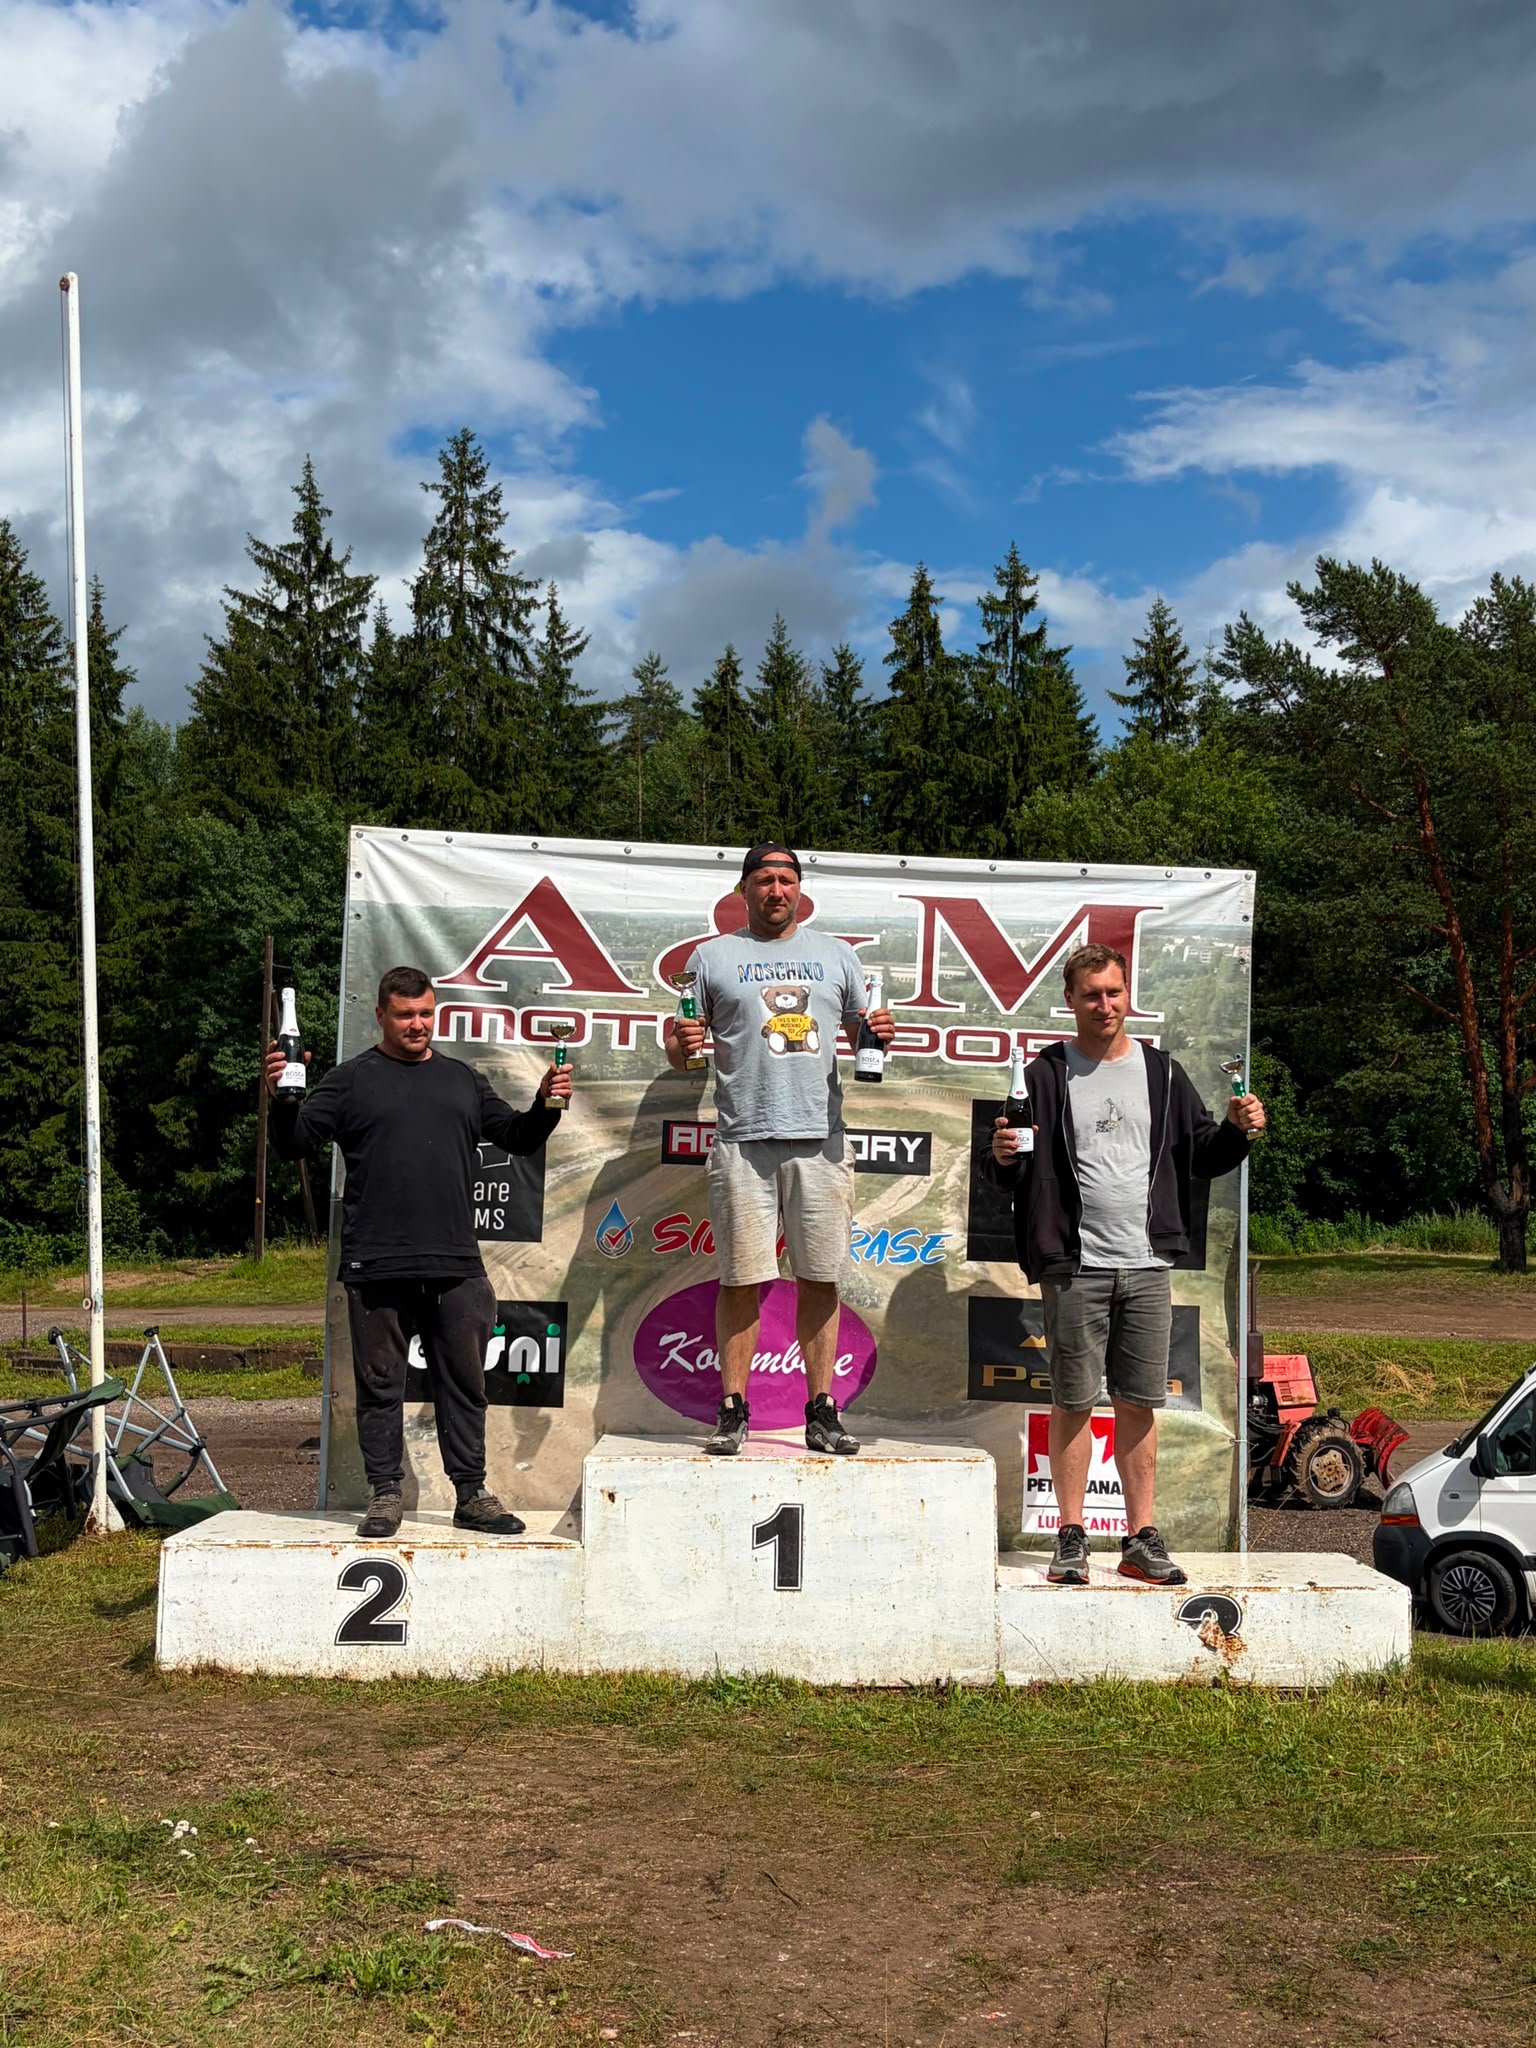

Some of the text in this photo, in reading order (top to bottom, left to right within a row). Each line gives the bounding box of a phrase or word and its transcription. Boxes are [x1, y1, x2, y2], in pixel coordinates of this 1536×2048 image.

[431, 875, 650, 998] A
[888, 891, 1169, 1022] M
[737, 962, 824, 983] MOSCHINO
[473, 1181, 510, 1202] are
[474, 1207, 505, 1230] MS
[752, 1503, 804, 1591] 1
[334, 1557, 408, 1646] 2
